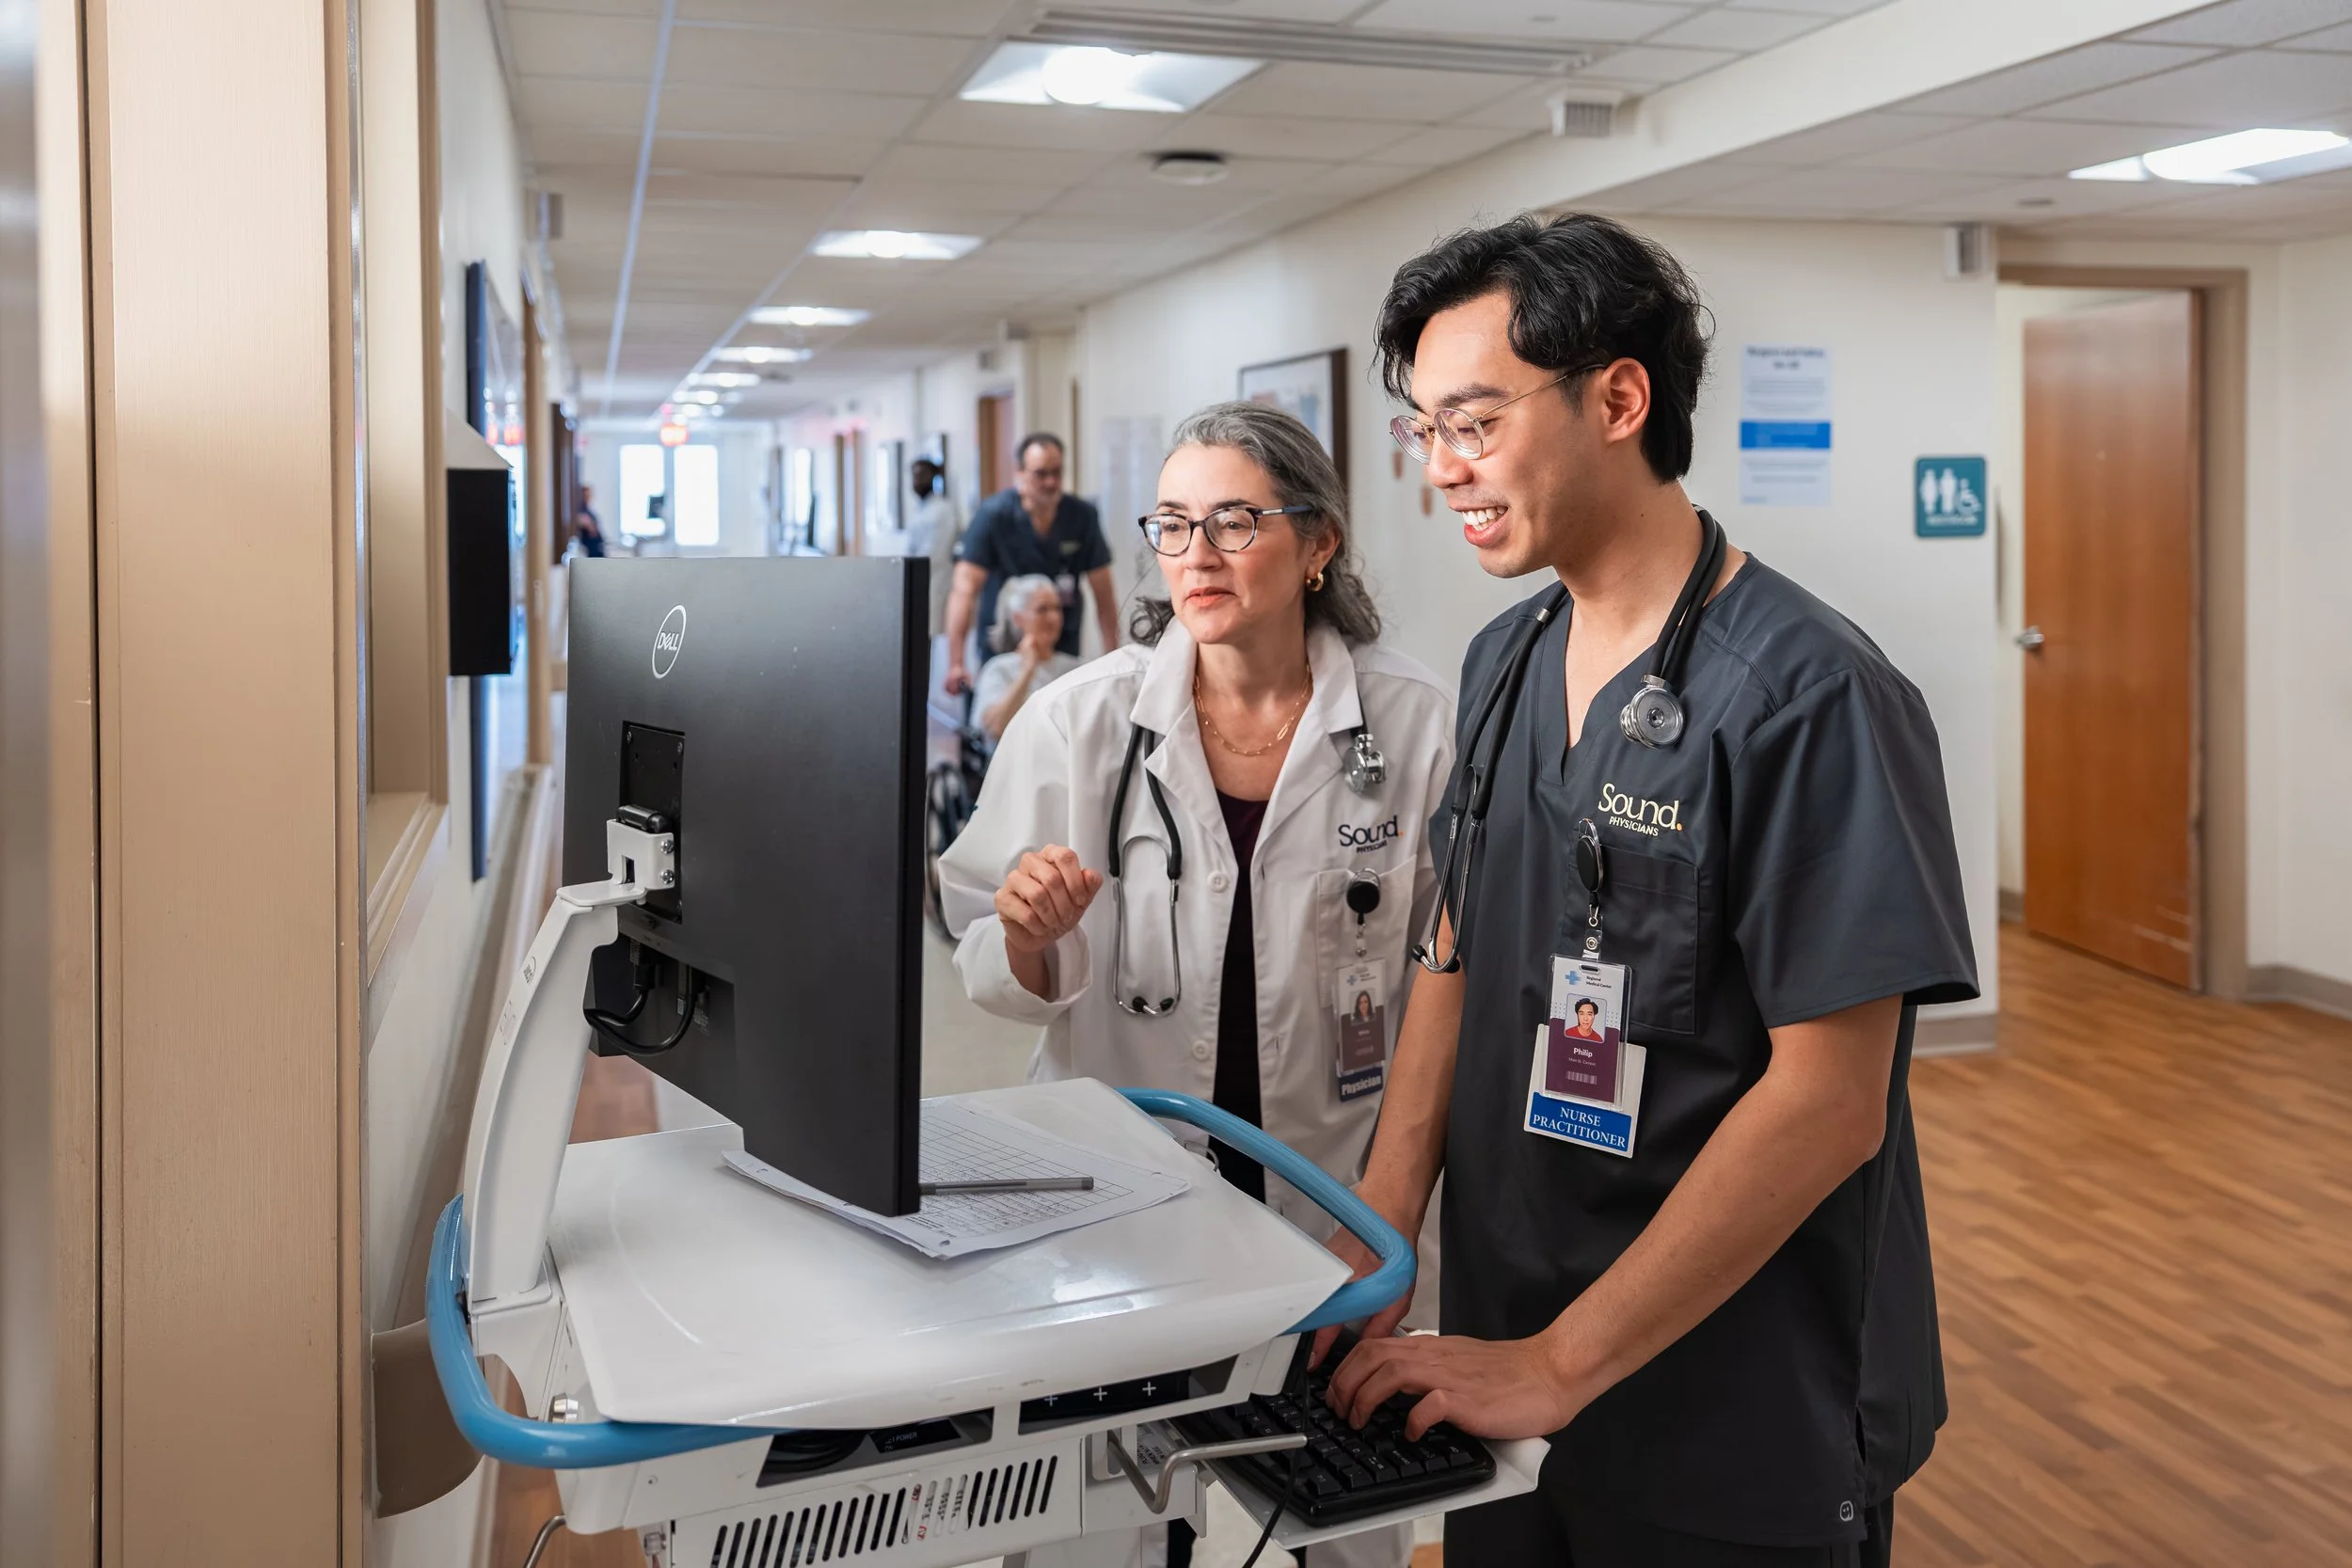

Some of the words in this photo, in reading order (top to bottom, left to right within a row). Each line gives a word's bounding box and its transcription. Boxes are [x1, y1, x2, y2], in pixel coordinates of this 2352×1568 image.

[657, 632, 679, 651] DELL
[1609, 816, 1660, 836] PHYSICIANS
[1573, 1047, 1594, 1058] Philip
[1341, 1075, 1382, 1096] Physician
[1560, 1106, 1601, 1127] NURSE
[1533, 1114, 1626, 1148] PRACTITIONER
[896, 1431, 918, 1442] POWER
